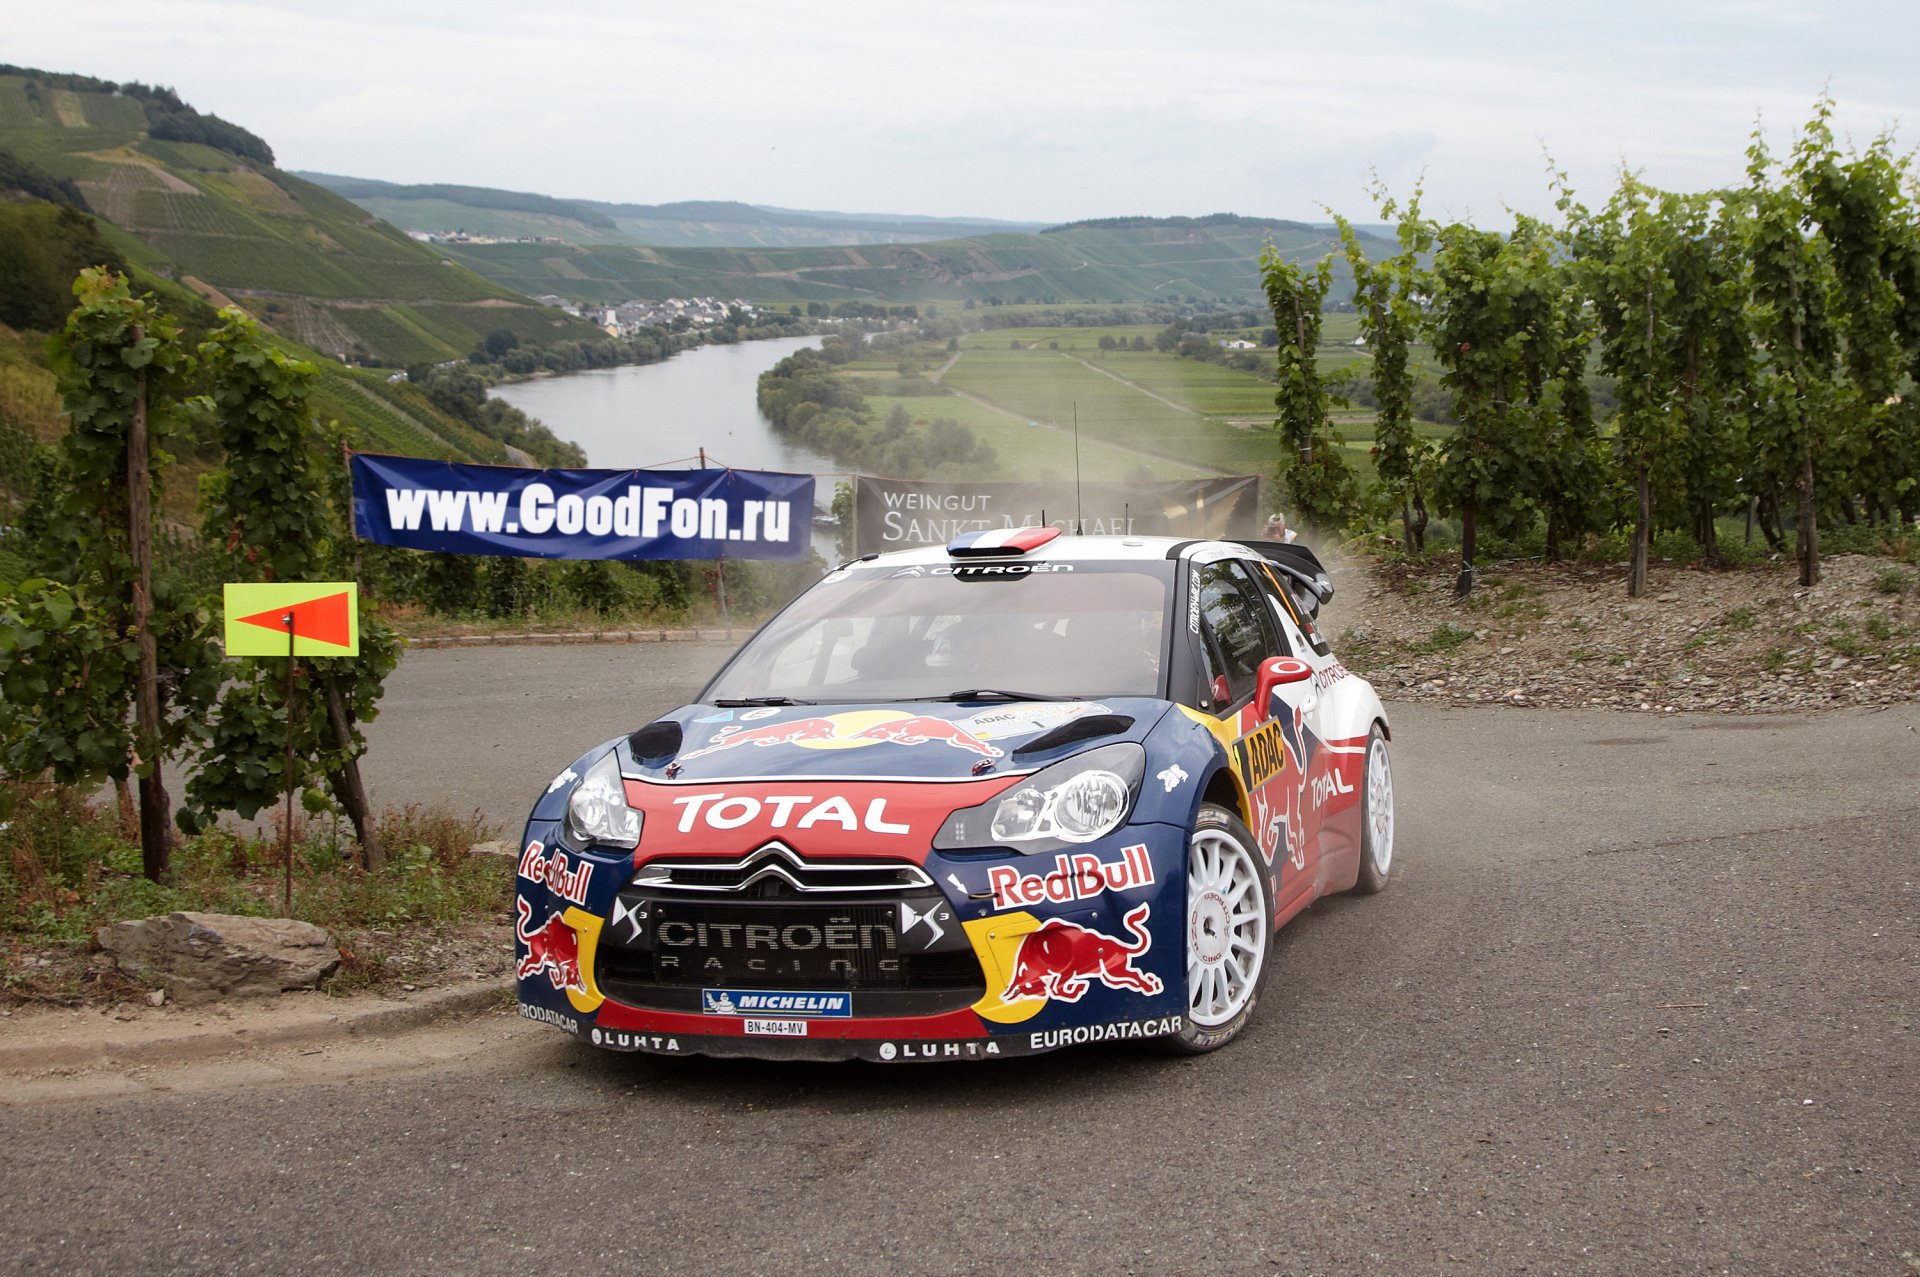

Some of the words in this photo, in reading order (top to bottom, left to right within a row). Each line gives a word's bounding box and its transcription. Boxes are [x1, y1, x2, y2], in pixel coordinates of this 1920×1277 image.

[884, 492, 992, 512] WEINGUT
[385, 483, 790, 542] www.GoodFon.ru
[1002, 513, 1138, 537] MCHAEL
[930, 561, 1074, 575] CITROËN
[974, 713, 1016, 725] ADAC
[1032, 720, 1045, 729] 1
[1249, 723, 1284, 786] ADAC
[1311, 768, 1354, 812] TOTAL
[673, 792, 910, 834] TOTAL
[660, 955, 899, 972] RACING
[738, 995, 844, 1010] MICHELIN
[747, 1021, 804, 1034] BN-404-MV
[1030, 1016, 1182, 1049] EURODATACAR
[605, 1032, 680, 1051] LUHTA
[903, 1041, 1001, 1057] LUHTA
